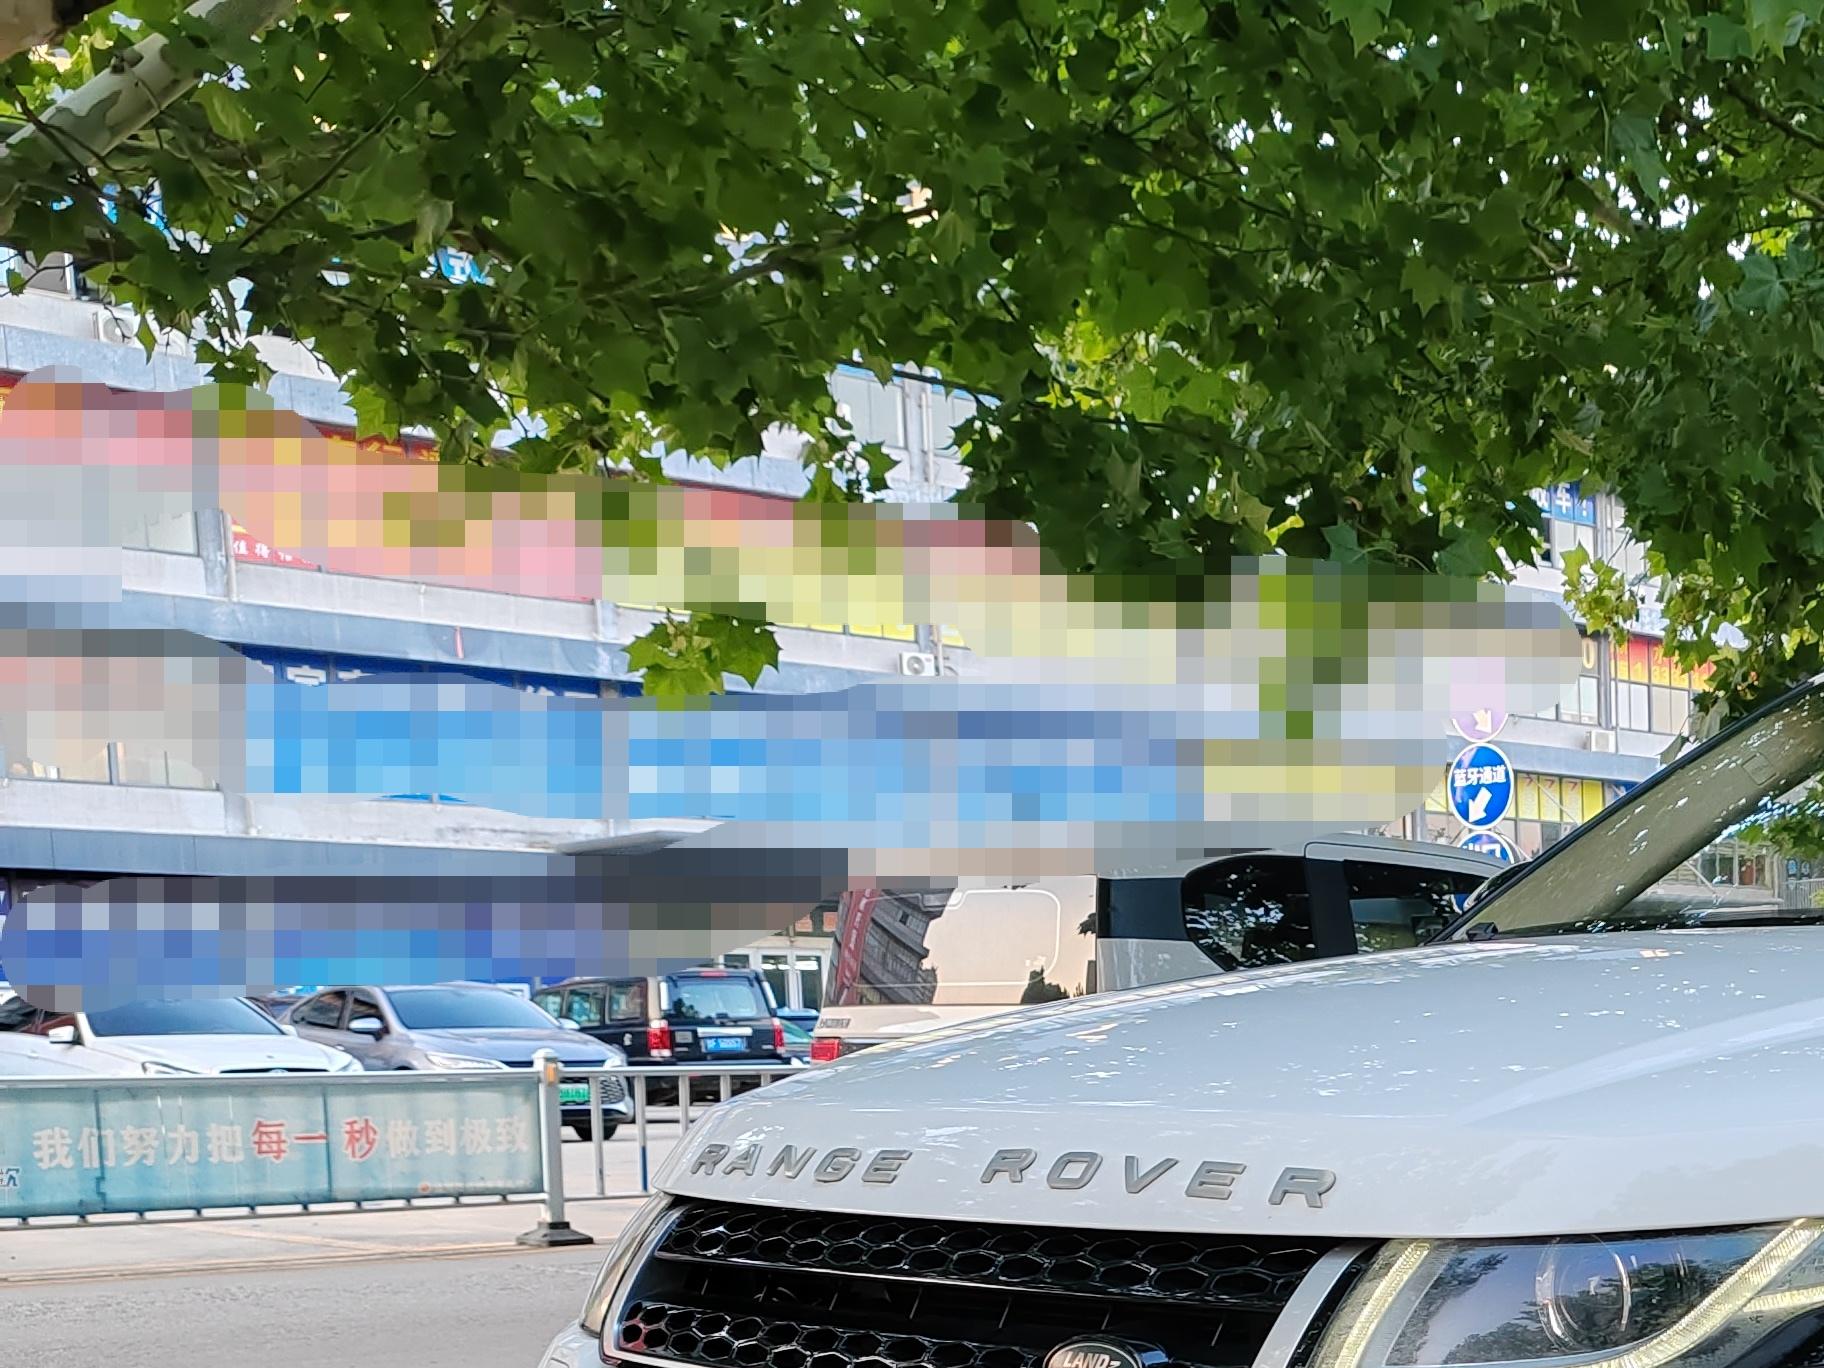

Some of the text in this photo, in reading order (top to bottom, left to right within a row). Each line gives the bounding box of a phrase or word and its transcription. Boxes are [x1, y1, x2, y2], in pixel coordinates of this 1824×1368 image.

[1453, 764, 1507, 787] 蓝牙通道
[32, 1114, 530, 1170] 我们努力把每一秒做到极致
[690, 1142, 1337, 1208] RANGE ROVER
